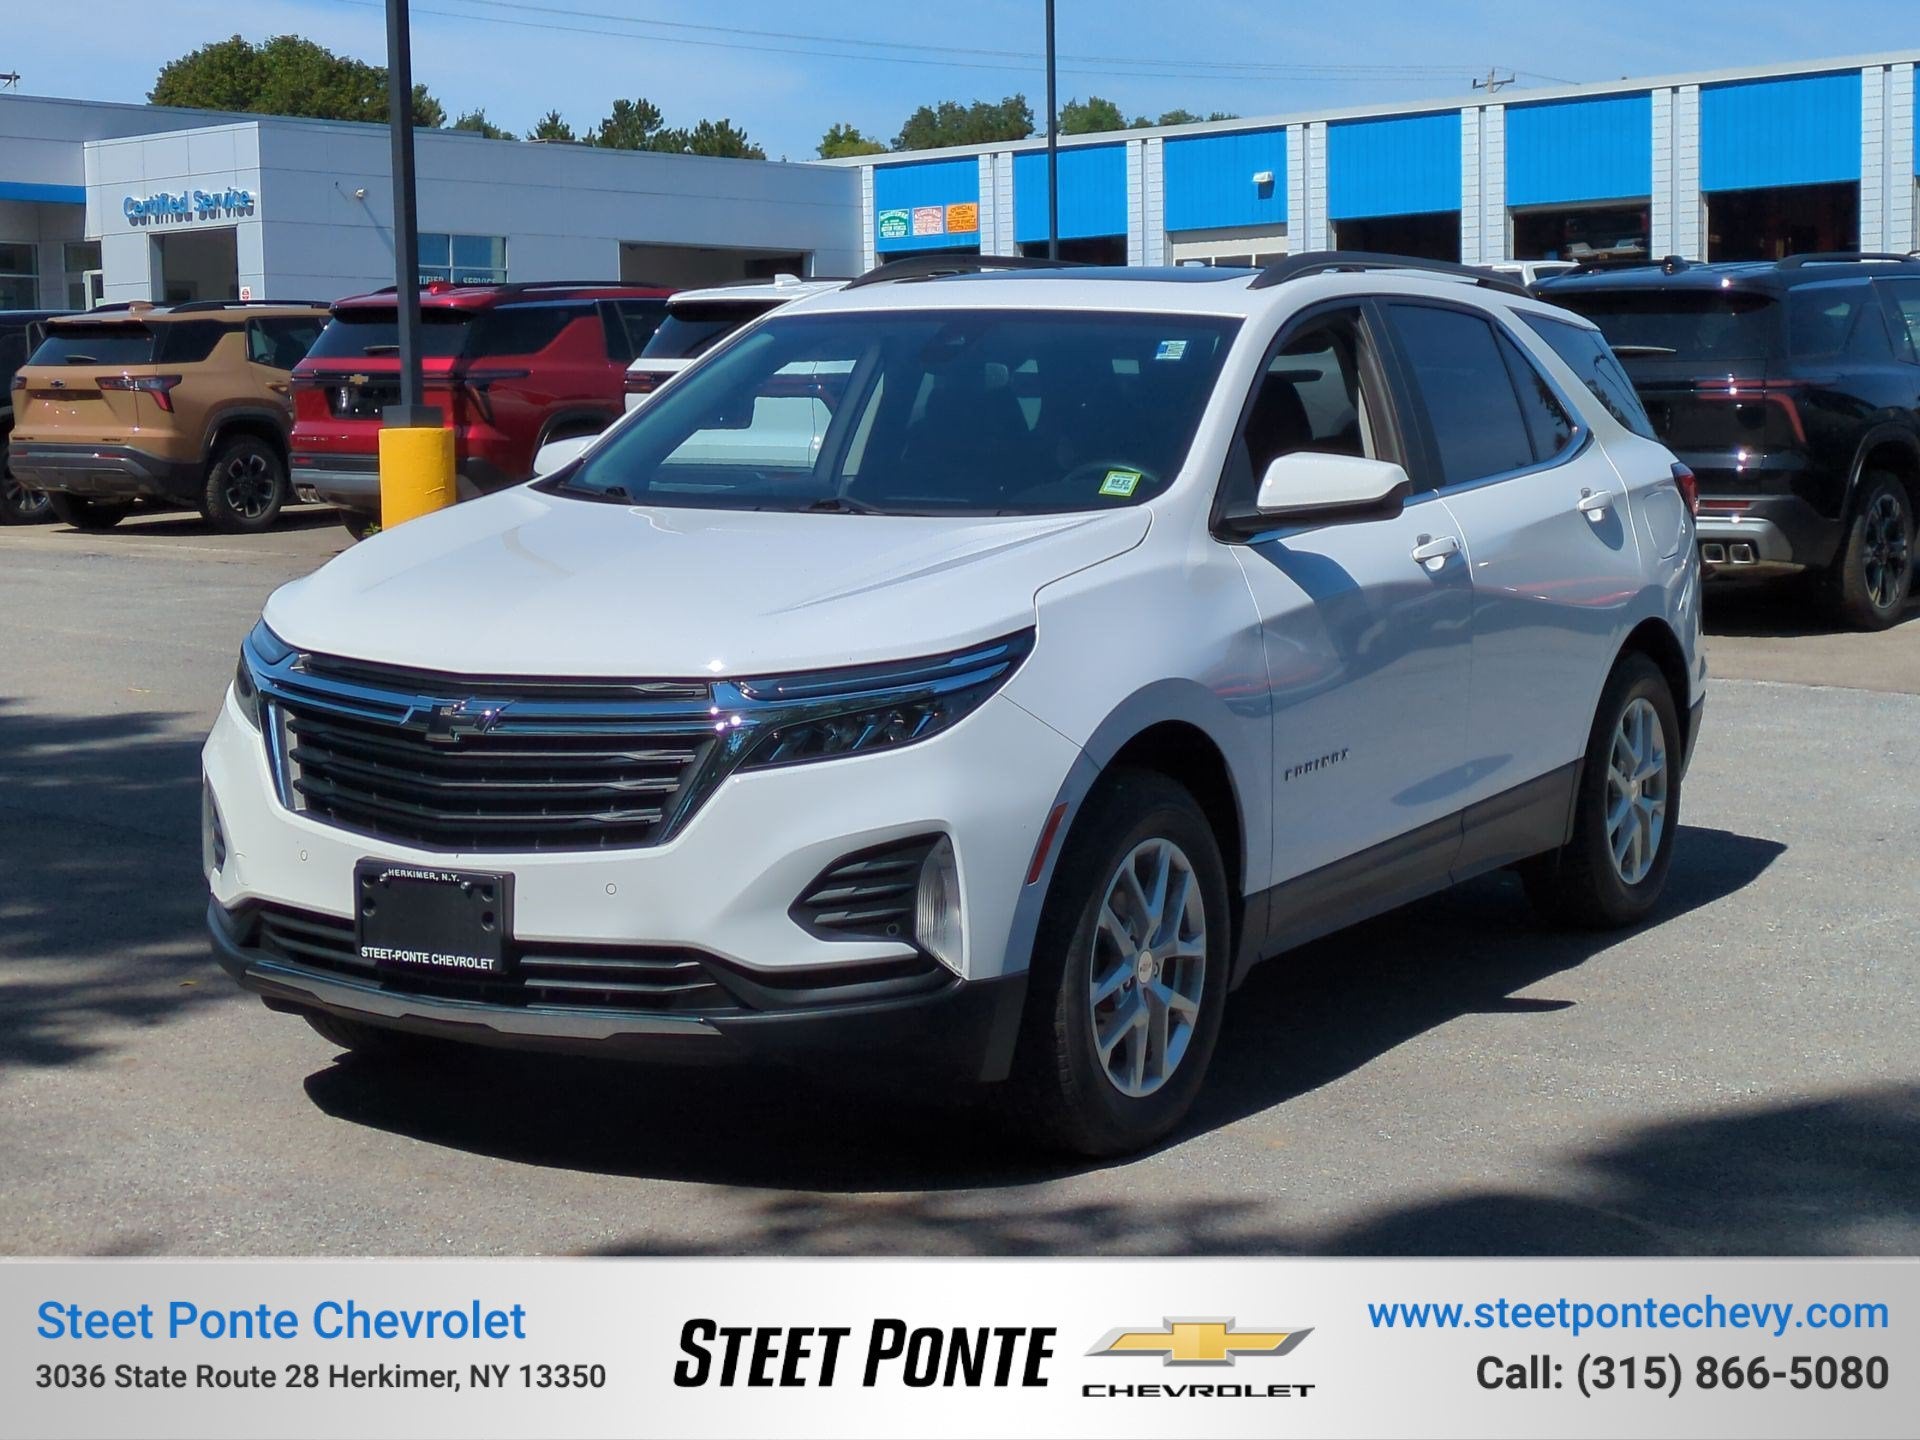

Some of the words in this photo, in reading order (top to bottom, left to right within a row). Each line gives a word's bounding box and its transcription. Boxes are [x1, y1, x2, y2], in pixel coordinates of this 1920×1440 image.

[123, 190, 190, 219] Certified
[193, 186, 252, 213] Service
[388, 868, 439, 882] HERKIMER,
[441, 873, 460, 882] N.Y.
[361, 946, 430, 964] STEET-PONTE
[431, 953, 495, 970] CHEVROLET
